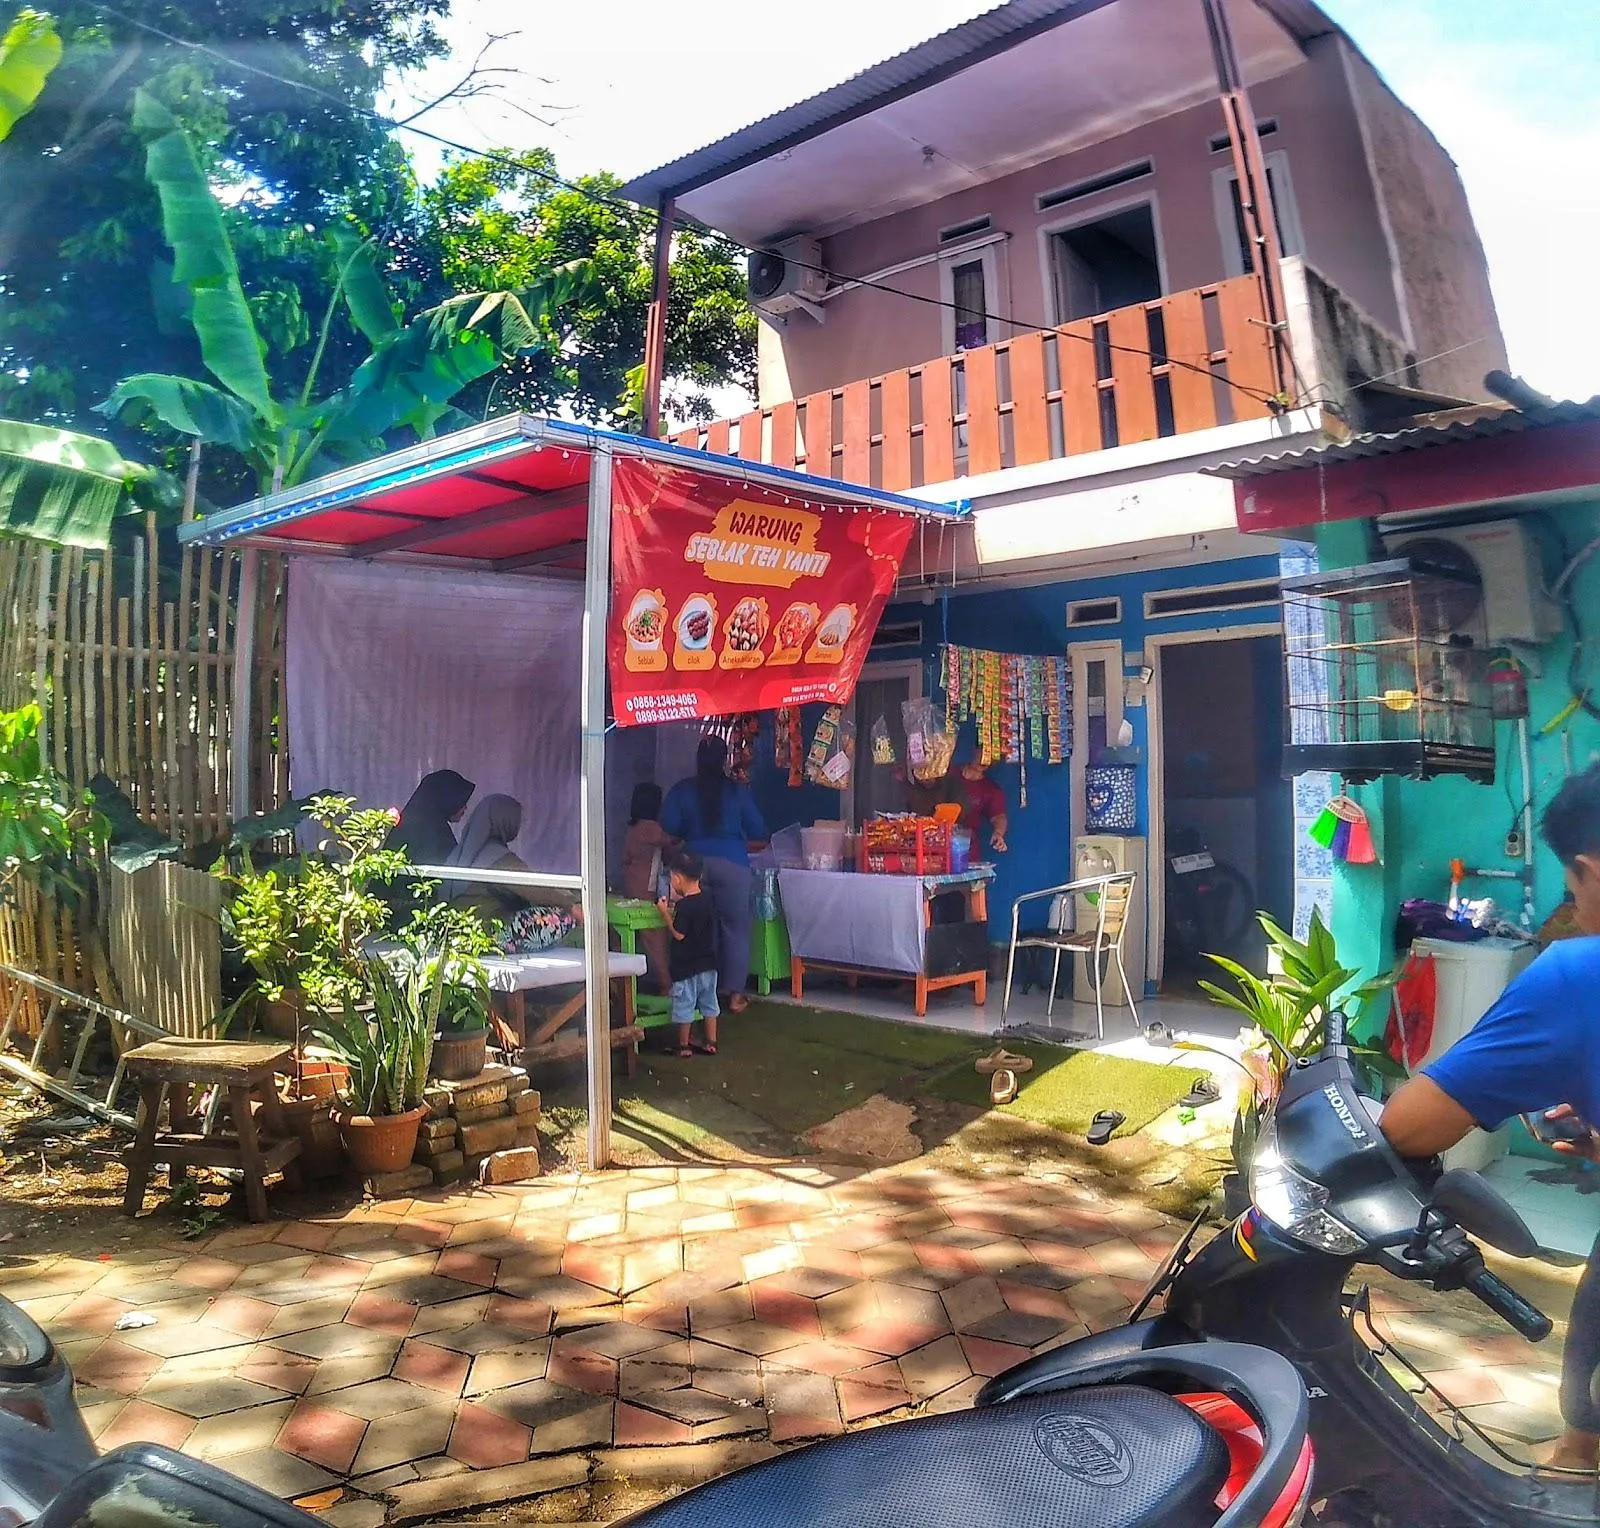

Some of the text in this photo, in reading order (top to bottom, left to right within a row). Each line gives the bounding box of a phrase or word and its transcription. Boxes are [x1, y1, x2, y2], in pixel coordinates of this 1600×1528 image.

[729, 511, 803, 546] WARUNG
[686, 535, 830, 575] SEBLAK TEH YANTI
[632, 693, 698, 710] 0858-1349-4063
